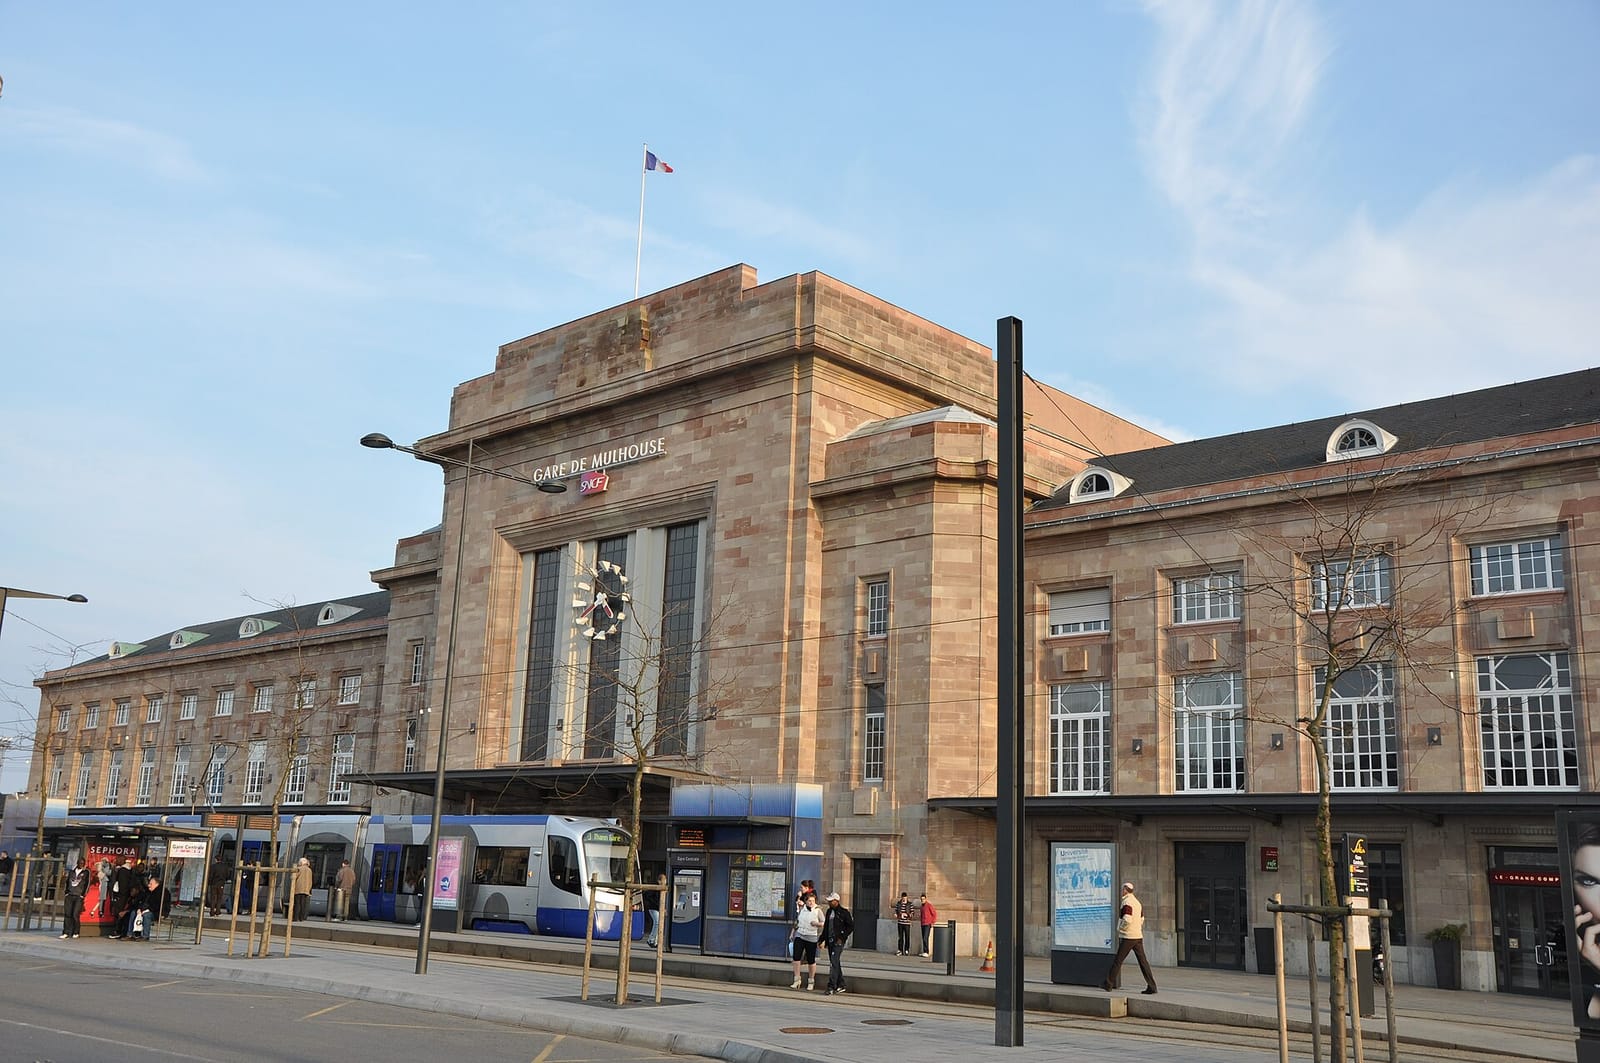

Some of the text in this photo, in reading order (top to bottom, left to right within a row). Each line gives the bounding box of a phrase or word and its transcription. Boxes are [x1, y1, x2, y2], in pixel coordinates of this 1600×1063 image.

[533, 437, 665, 482] GARE DE MULHOUSE
[580, 476, 605, 493] SNCF
[90, 846, 136, 855] SEPHORA
